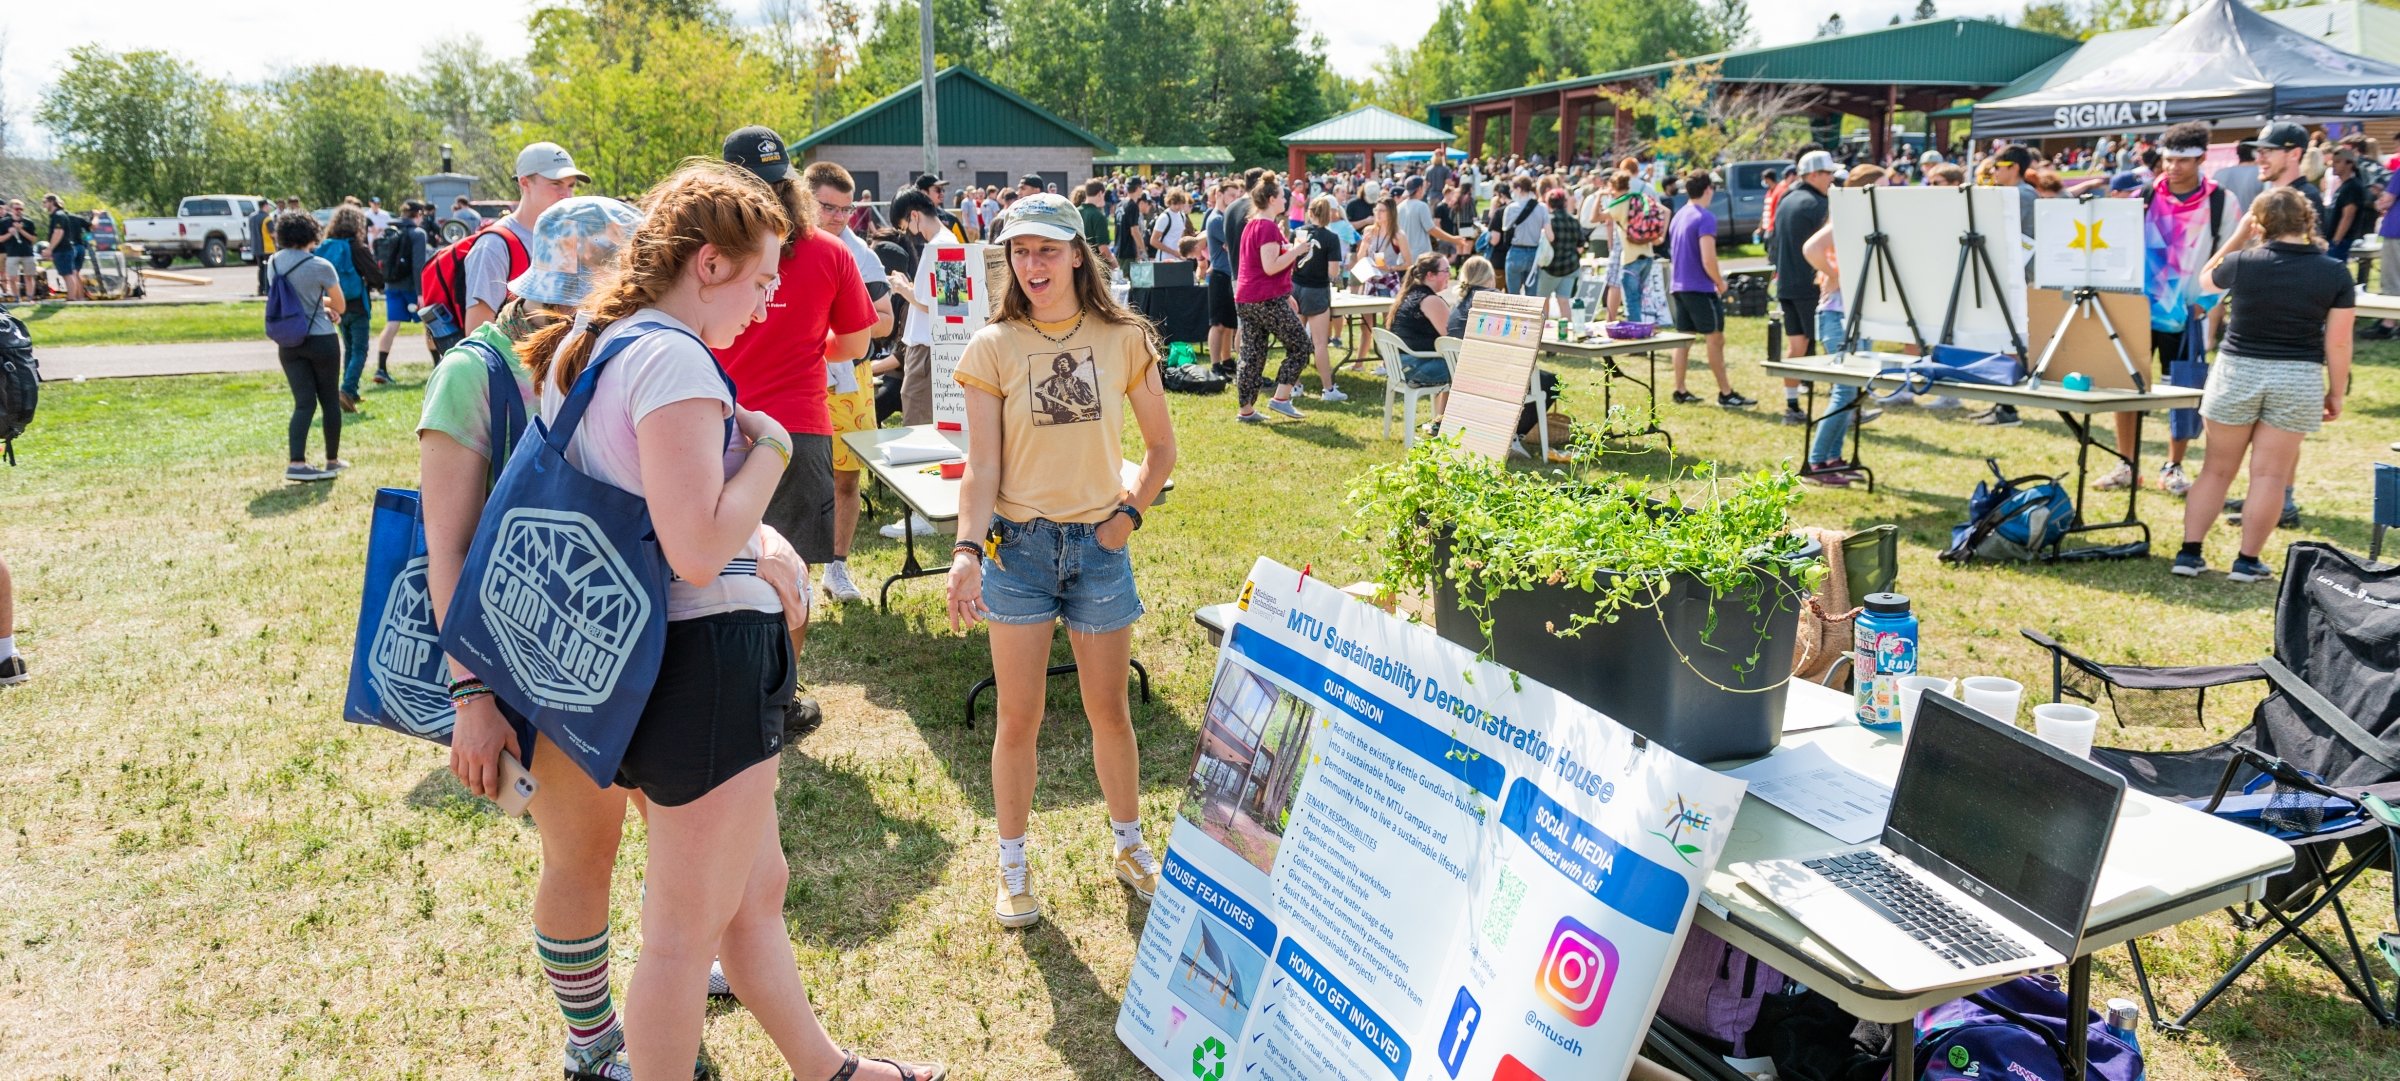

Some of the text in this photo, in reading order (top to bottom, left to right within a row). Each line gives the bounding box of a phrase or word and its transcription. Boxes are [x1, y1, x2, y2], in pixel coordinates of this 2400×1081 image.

[2053, 100, 2168, 130] SIGMA PI
[2343, 88, 2400, 113] SIGMA
[931, 325, 972, 342] Guatemala
[1254, 587, 1277, 604] Michigan
[2316, 575, 2334, 587] Let's
[487, 567, 614, 690] CAMP K-DAY
[1252, 596, 1286, 618] Technological
[378, 627, 431, 678] CAMP
[459, 635, 481, 657] Michigan
[1887, 658, 1911, 671] RAD
[1285, 607, 1617, 806] MTU Sustainability Demonstration House
[1323, 678, 1384, 723] OUR MISSION
[1328, 738, 1341, 753] into
[1345, 750, 1384, 780] sustainable
[1383, 772, 1406, 795] house
[1332, 722, 1487, 826] Retrofit the existing Kettle Gundlach building
[1304, 792, 1378, 850] TENANT RESPONSIBILITIES
[1323, 756, 1447, 845] Demonstrate to the MTU campus and
[1679, 807, 1712, 832] AEE
[1306, 811, 1355, 854] Host open houses
[1319, 773, 1354, 804] community
[1354, 795, 1370, 814] how
[1369, 807, 1378, 820] to
[1377, 811, 1392, 829] live
[1396, 826, 1437, 860] sustainable
[1437, 852, 1468, 883] lifestyle
[1535, 805, 1616, 875] SOCIAL MEDIA
[1297, 839, 1309, 855] Live
[1313, 852, 1346, 883] sustainable
[1345, 876, 1369, 901] lifestyle
[1302, 825, 1391, 900] Organize community workshops
[1530, 831, 1603, 895] Connect with Us!
[1164, 857, 1255, 932] HOUSE FEATURES
[1167, 897, 1180, 911] array
[1292, 853, 1394, 940] Collect energy and water usage data
[1957, 877, 1985, 898] ASUS
[1154, 927, 1172, 947] systems
[1169, 912, 1180, 924] unit
[1277, 896, 1376, 986] Start personal sustainable projects!
[1287, 868, 1409, 974] Give campus and community presentations
[1149, 938, 1172, 963] gardening
[1282, 881, 1423, 1007] Assist the Alternative Energy Enterprise SDH team
[1133, 996, 1150, 1019] tracking
[1135, 1012, 1154, 1035] showers
[1285, 981, 1351, 1050] Sign-up for our email list
[1287, 951, 1401, 1064] HOW TO GET INVOLVED
[1265, 1038, 1288, 1066] Sign-up
[1287, 1059, 1297, 1073] for
[1276, 1009, 1294, 1032] Attend
[1293, 1027, 1303, 1042] our
[1304, 1037, 1322, 1059] virtual
[1321, 1056, 1337, 1076] open
[1525, 1010, 1583, 1057] @mtusdh
